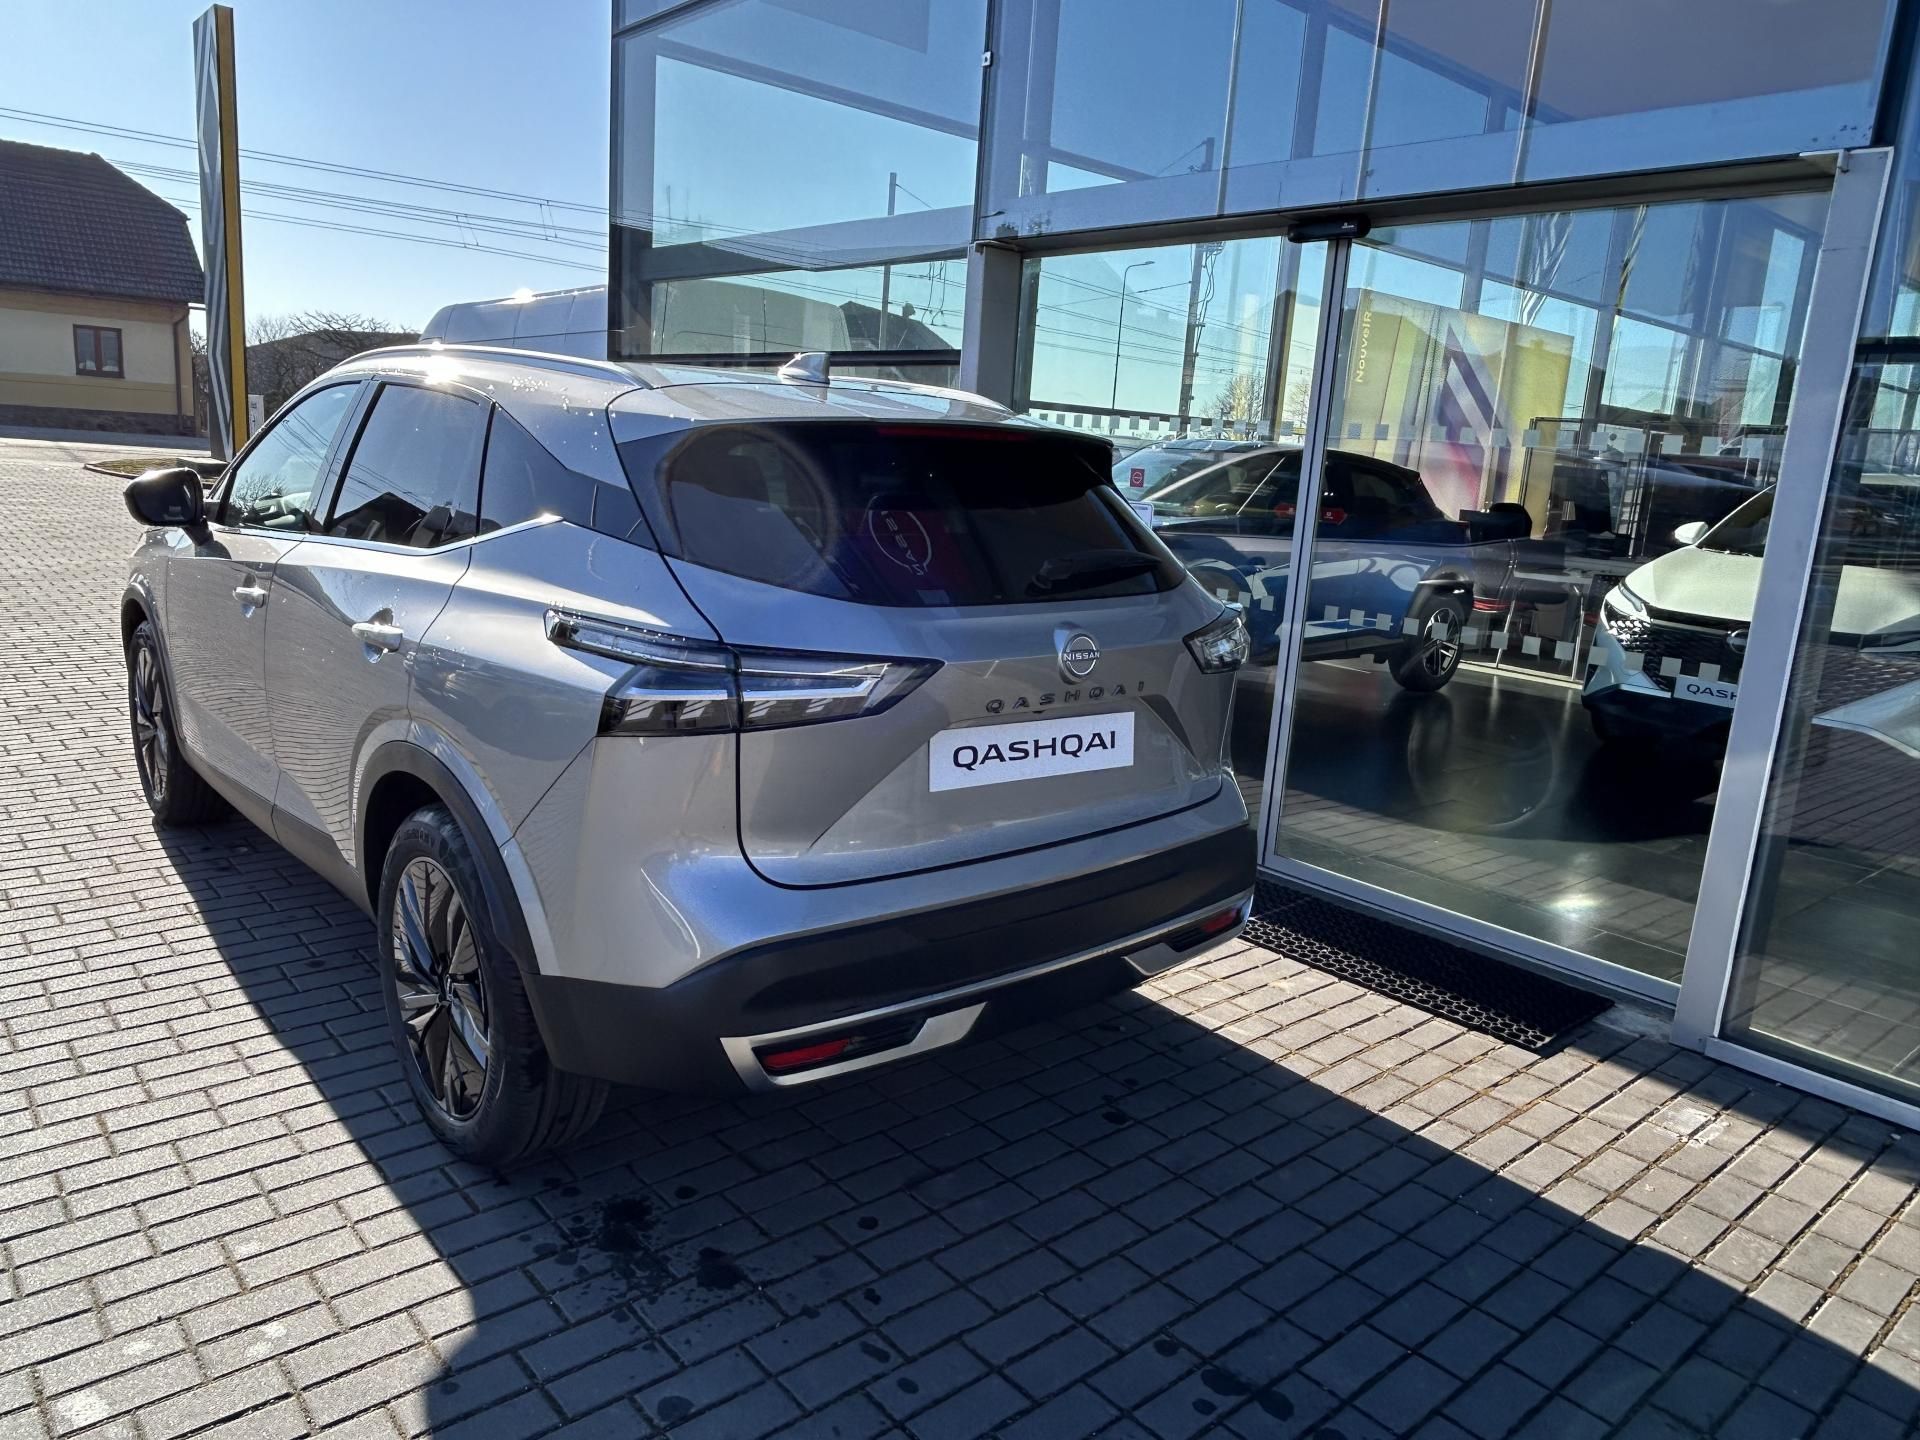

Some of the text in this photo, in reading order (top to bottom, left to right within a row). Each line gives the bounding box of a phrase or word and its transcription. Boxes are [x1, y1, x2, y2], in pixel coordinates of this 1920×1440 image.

[1063, 651, 1100, 661] NISSAN
[985, 681, 1145, 713] QASHQAI
[953, 730, 1116, 771] QASHQAI
